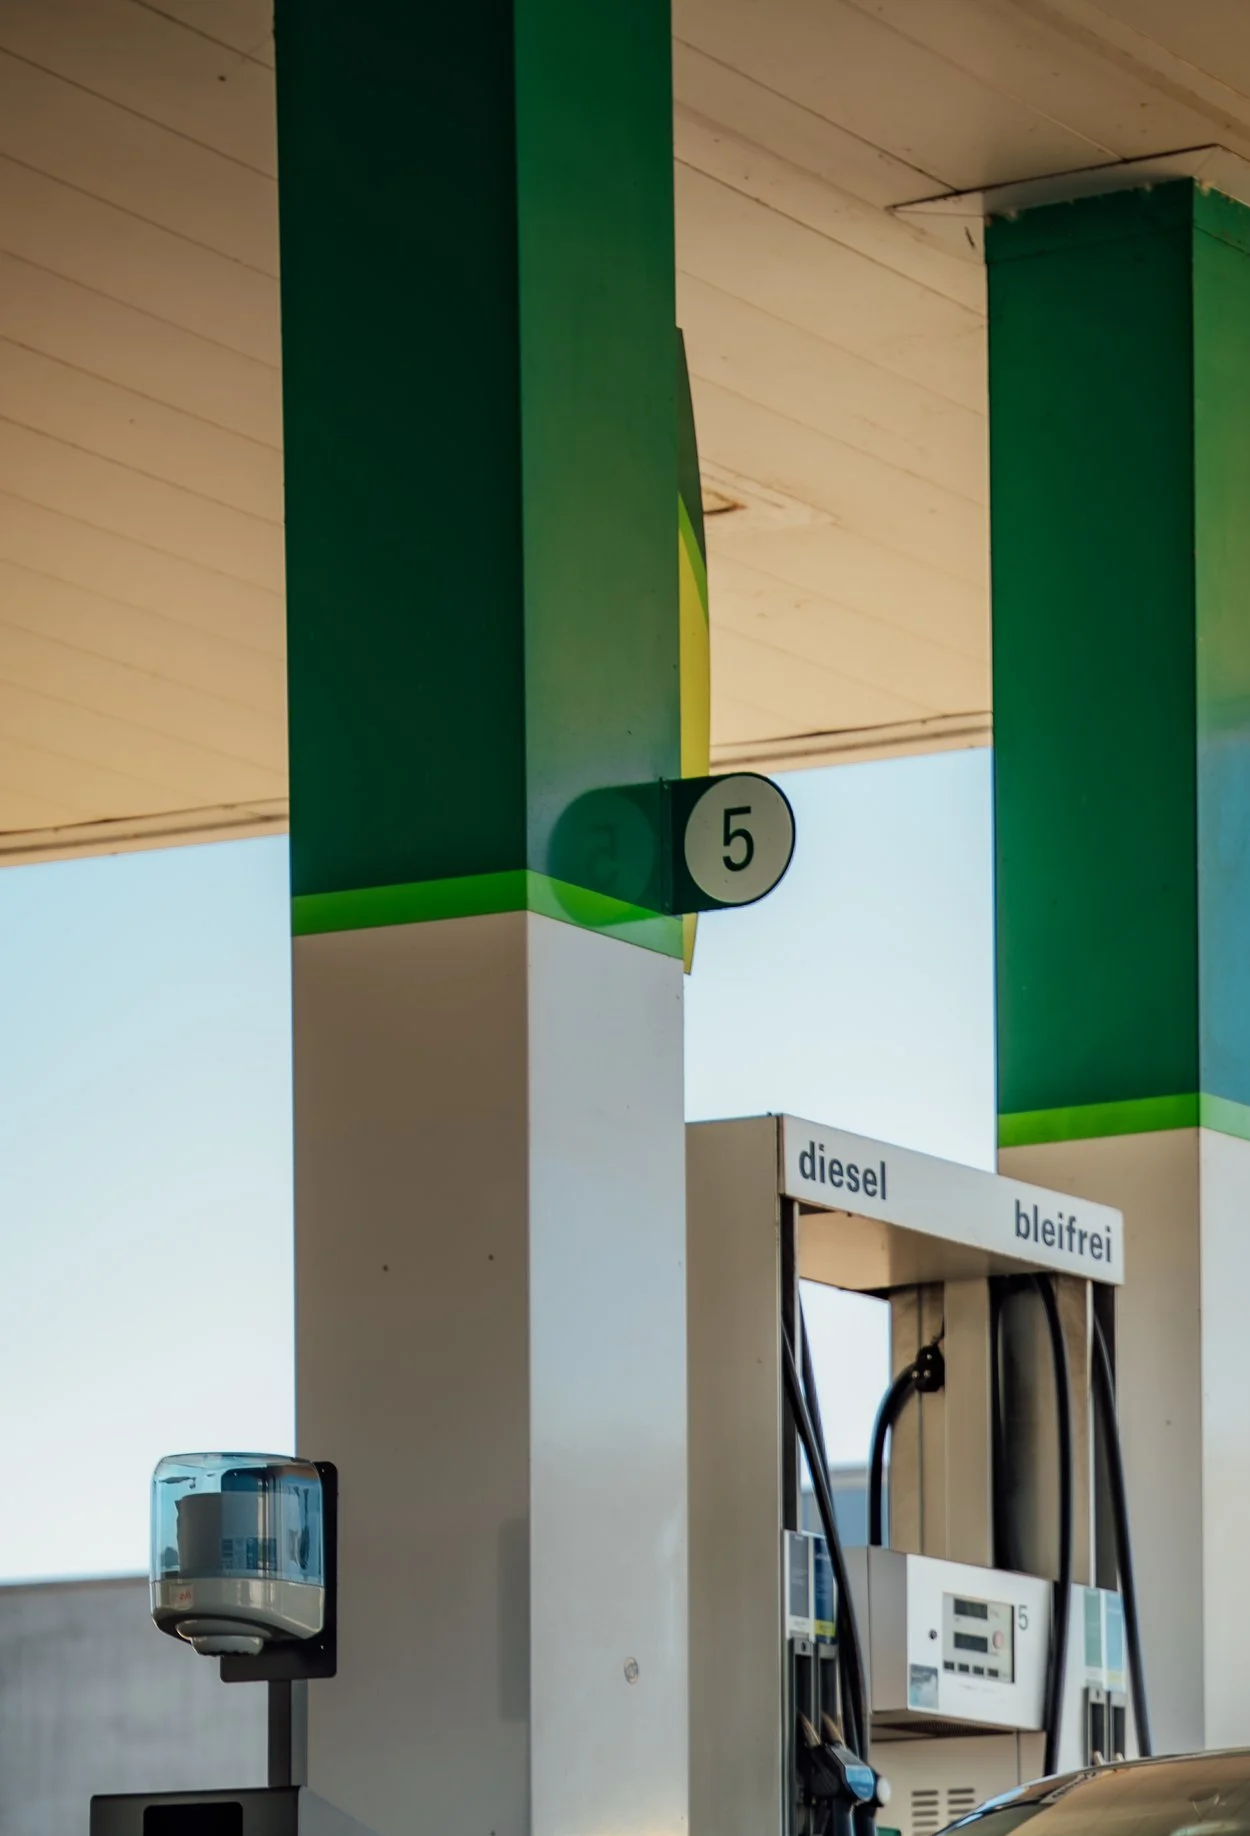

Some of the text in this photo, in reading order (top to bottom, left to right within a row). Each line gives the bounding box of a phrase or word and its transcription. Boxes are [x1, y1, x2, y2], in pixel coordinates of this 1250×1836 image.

[722, 805, 755, 873] 5
[798, 1141, 888, 1201] diesel
[1014, 1198, 1113, 1263] bleifrei
[1018, 1603, 1029, 1632] 5
